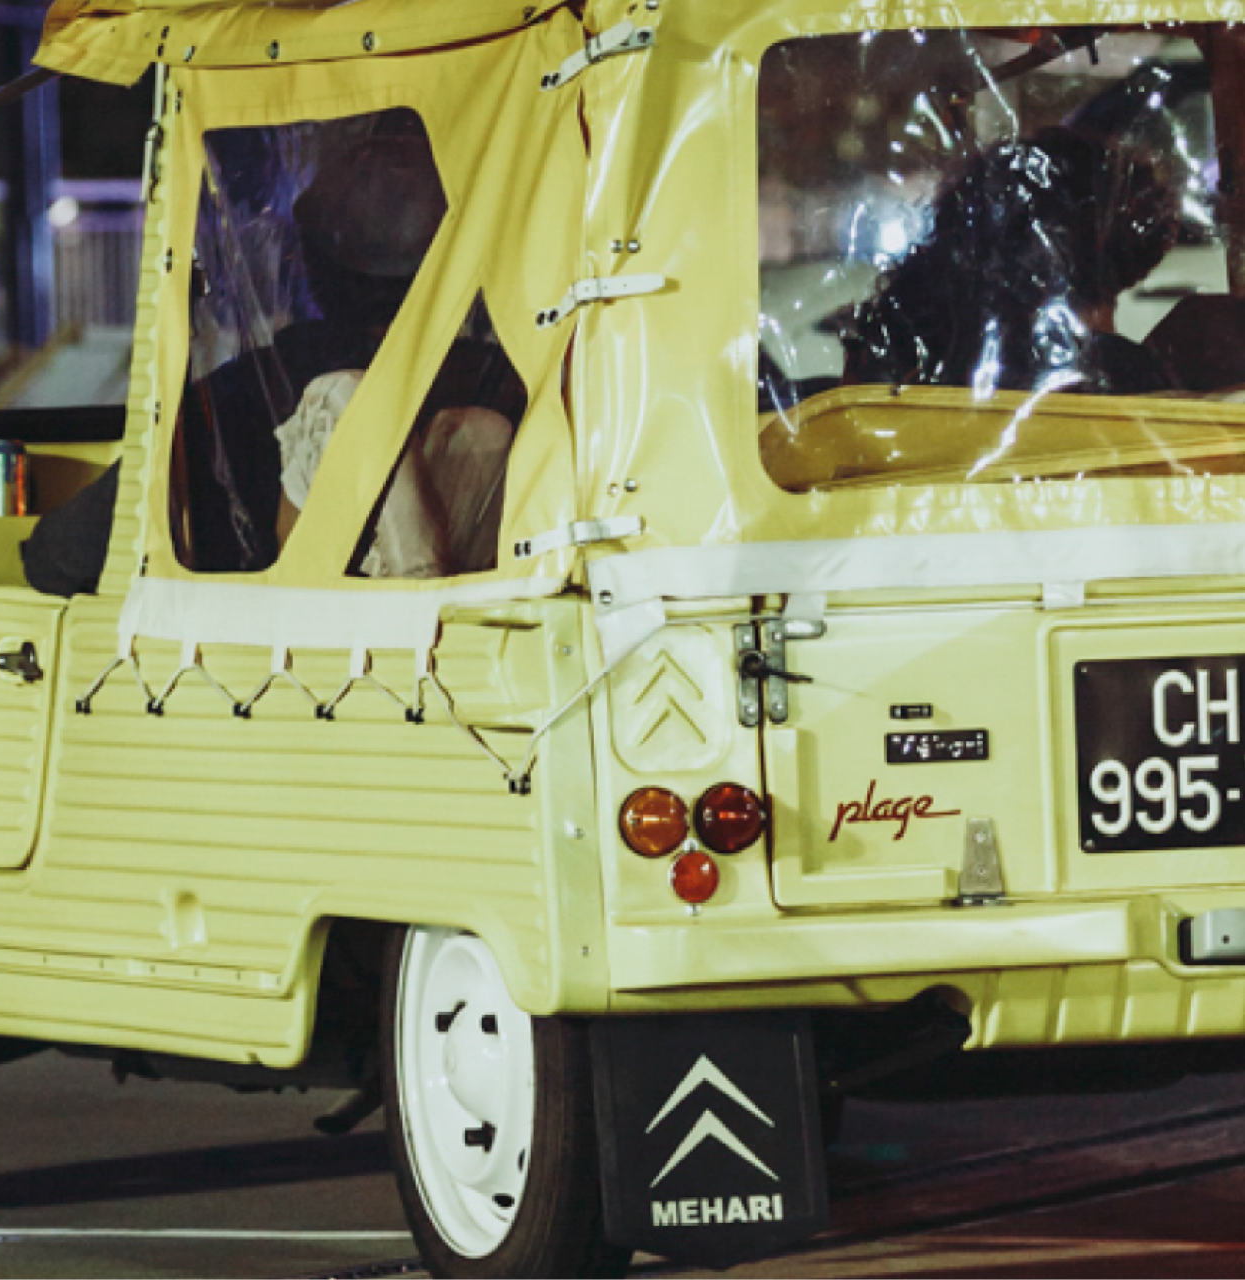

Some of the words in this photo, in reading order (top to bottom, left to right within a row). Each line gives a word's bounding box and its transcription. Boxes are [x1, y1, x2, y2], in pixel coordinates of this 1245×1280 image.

[1153, 669, 1240, 747] CH
[828, 779, 961, 842] plage
[651, 1193, 783, 1226] MEHARI
